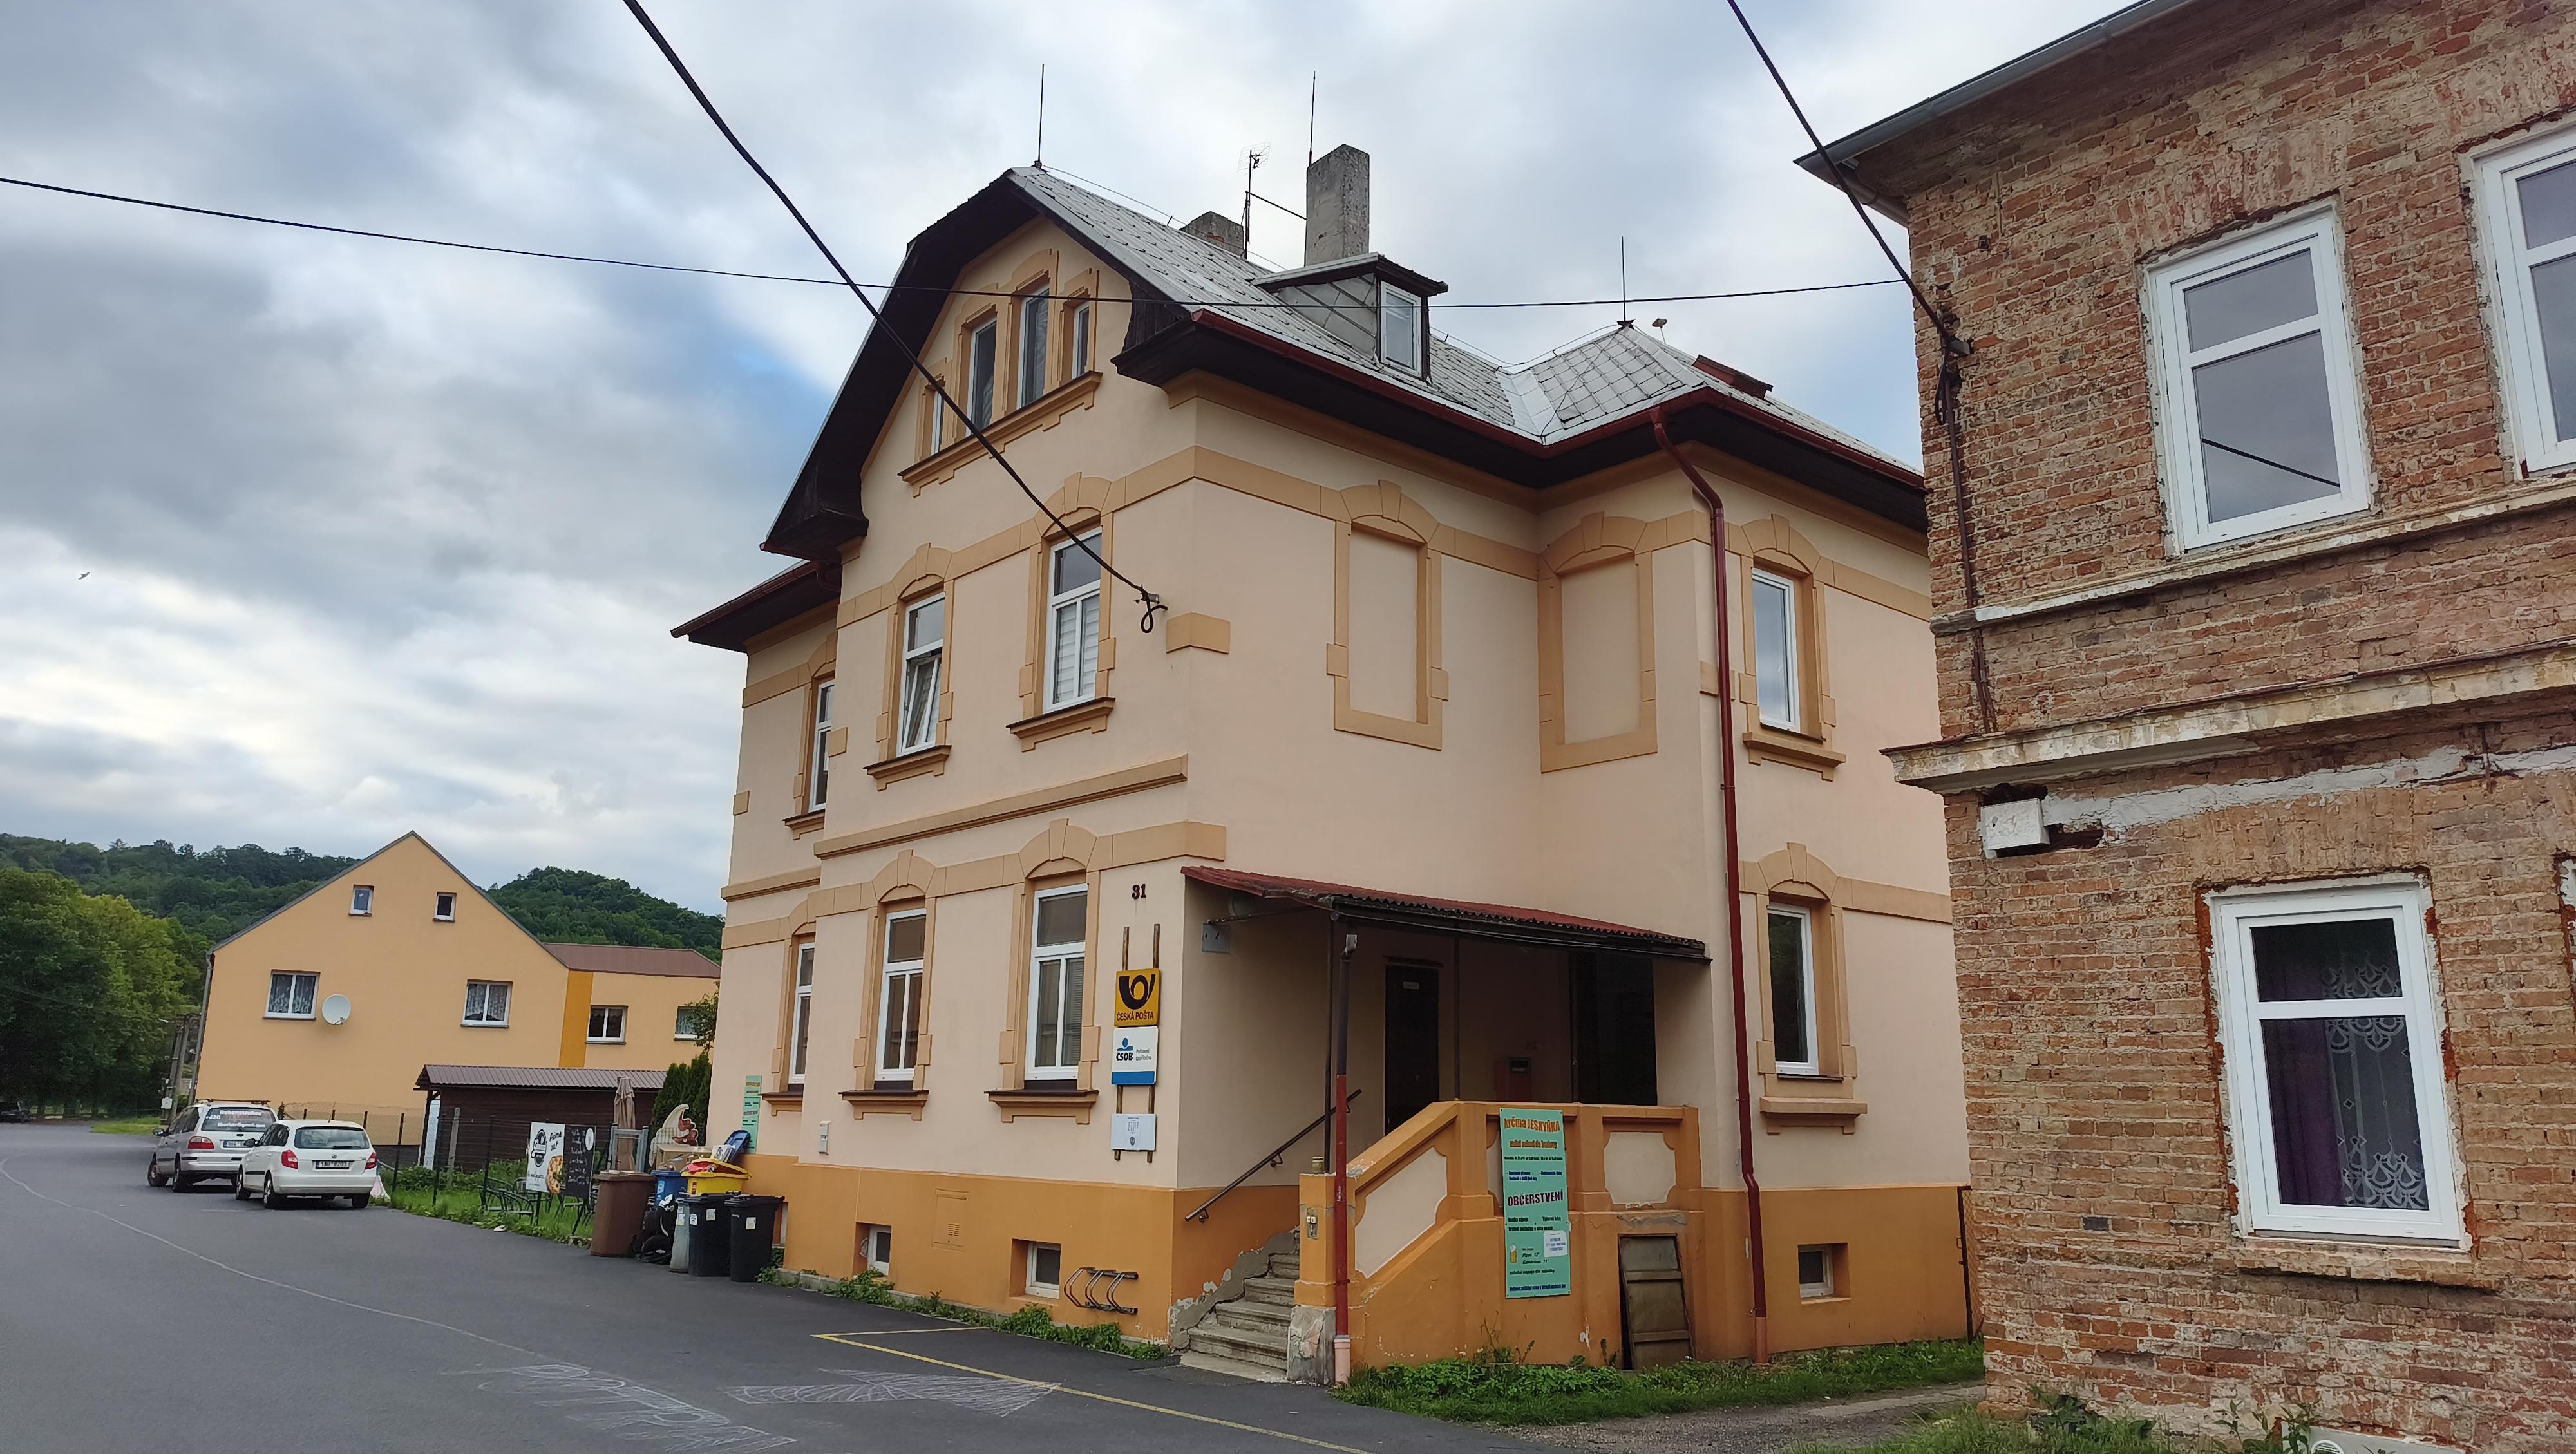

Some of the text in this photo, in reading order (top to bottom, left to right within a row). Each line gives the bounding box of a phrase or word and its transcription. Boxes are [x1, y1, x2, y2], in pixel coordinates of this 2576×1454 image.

[1132, 883, 1146, 900] 31
[1117, 1010, 1154, 1021] ČESKÁ POŠTA
[1116, 1052, 1133, 1061] ČSOB
[1504, 1116, 1560, 1132] krčma JESKYŇKA
[1508, 1189, 1564, 1206] OBČERSTVENÍ
